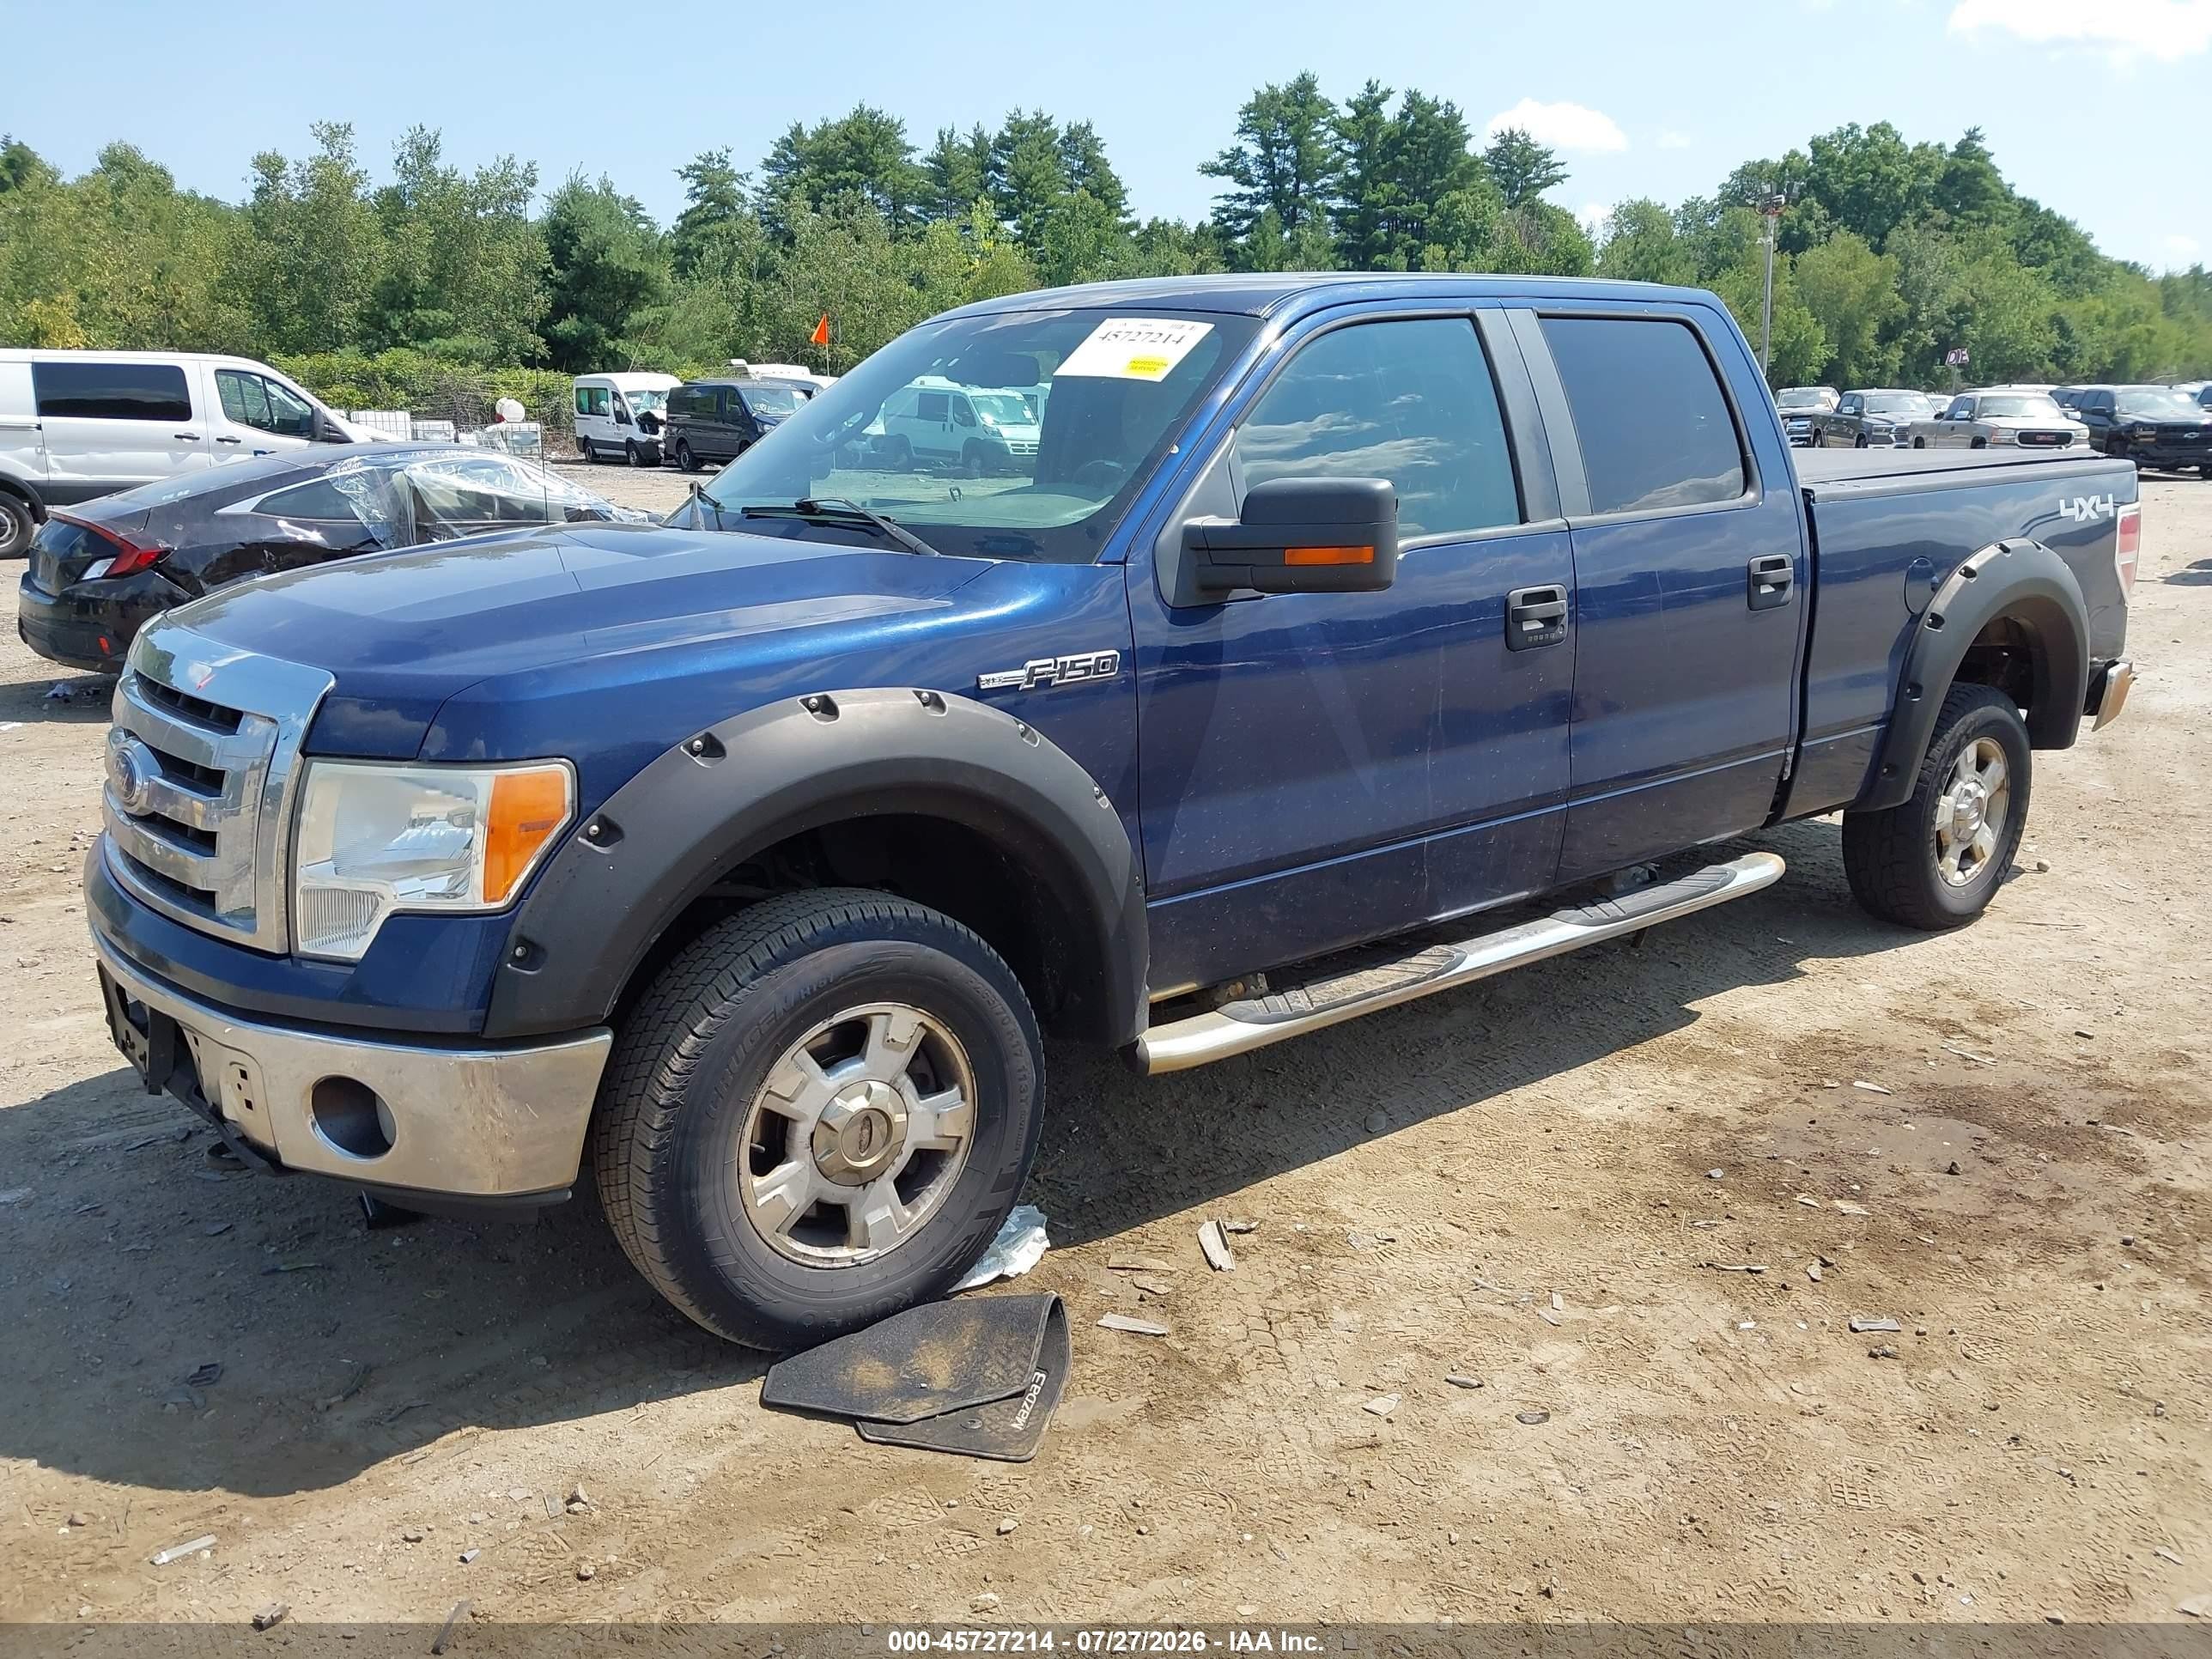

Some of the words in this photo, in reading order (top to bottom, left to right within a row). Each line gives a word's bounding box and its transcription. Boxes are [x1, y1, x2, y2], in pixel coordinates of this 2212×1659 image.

[1099, 330, 1187, 344] 45727214
[2059, 494, 2114, 522] 4X4
[1018, 649, 1121, 691] F-150
